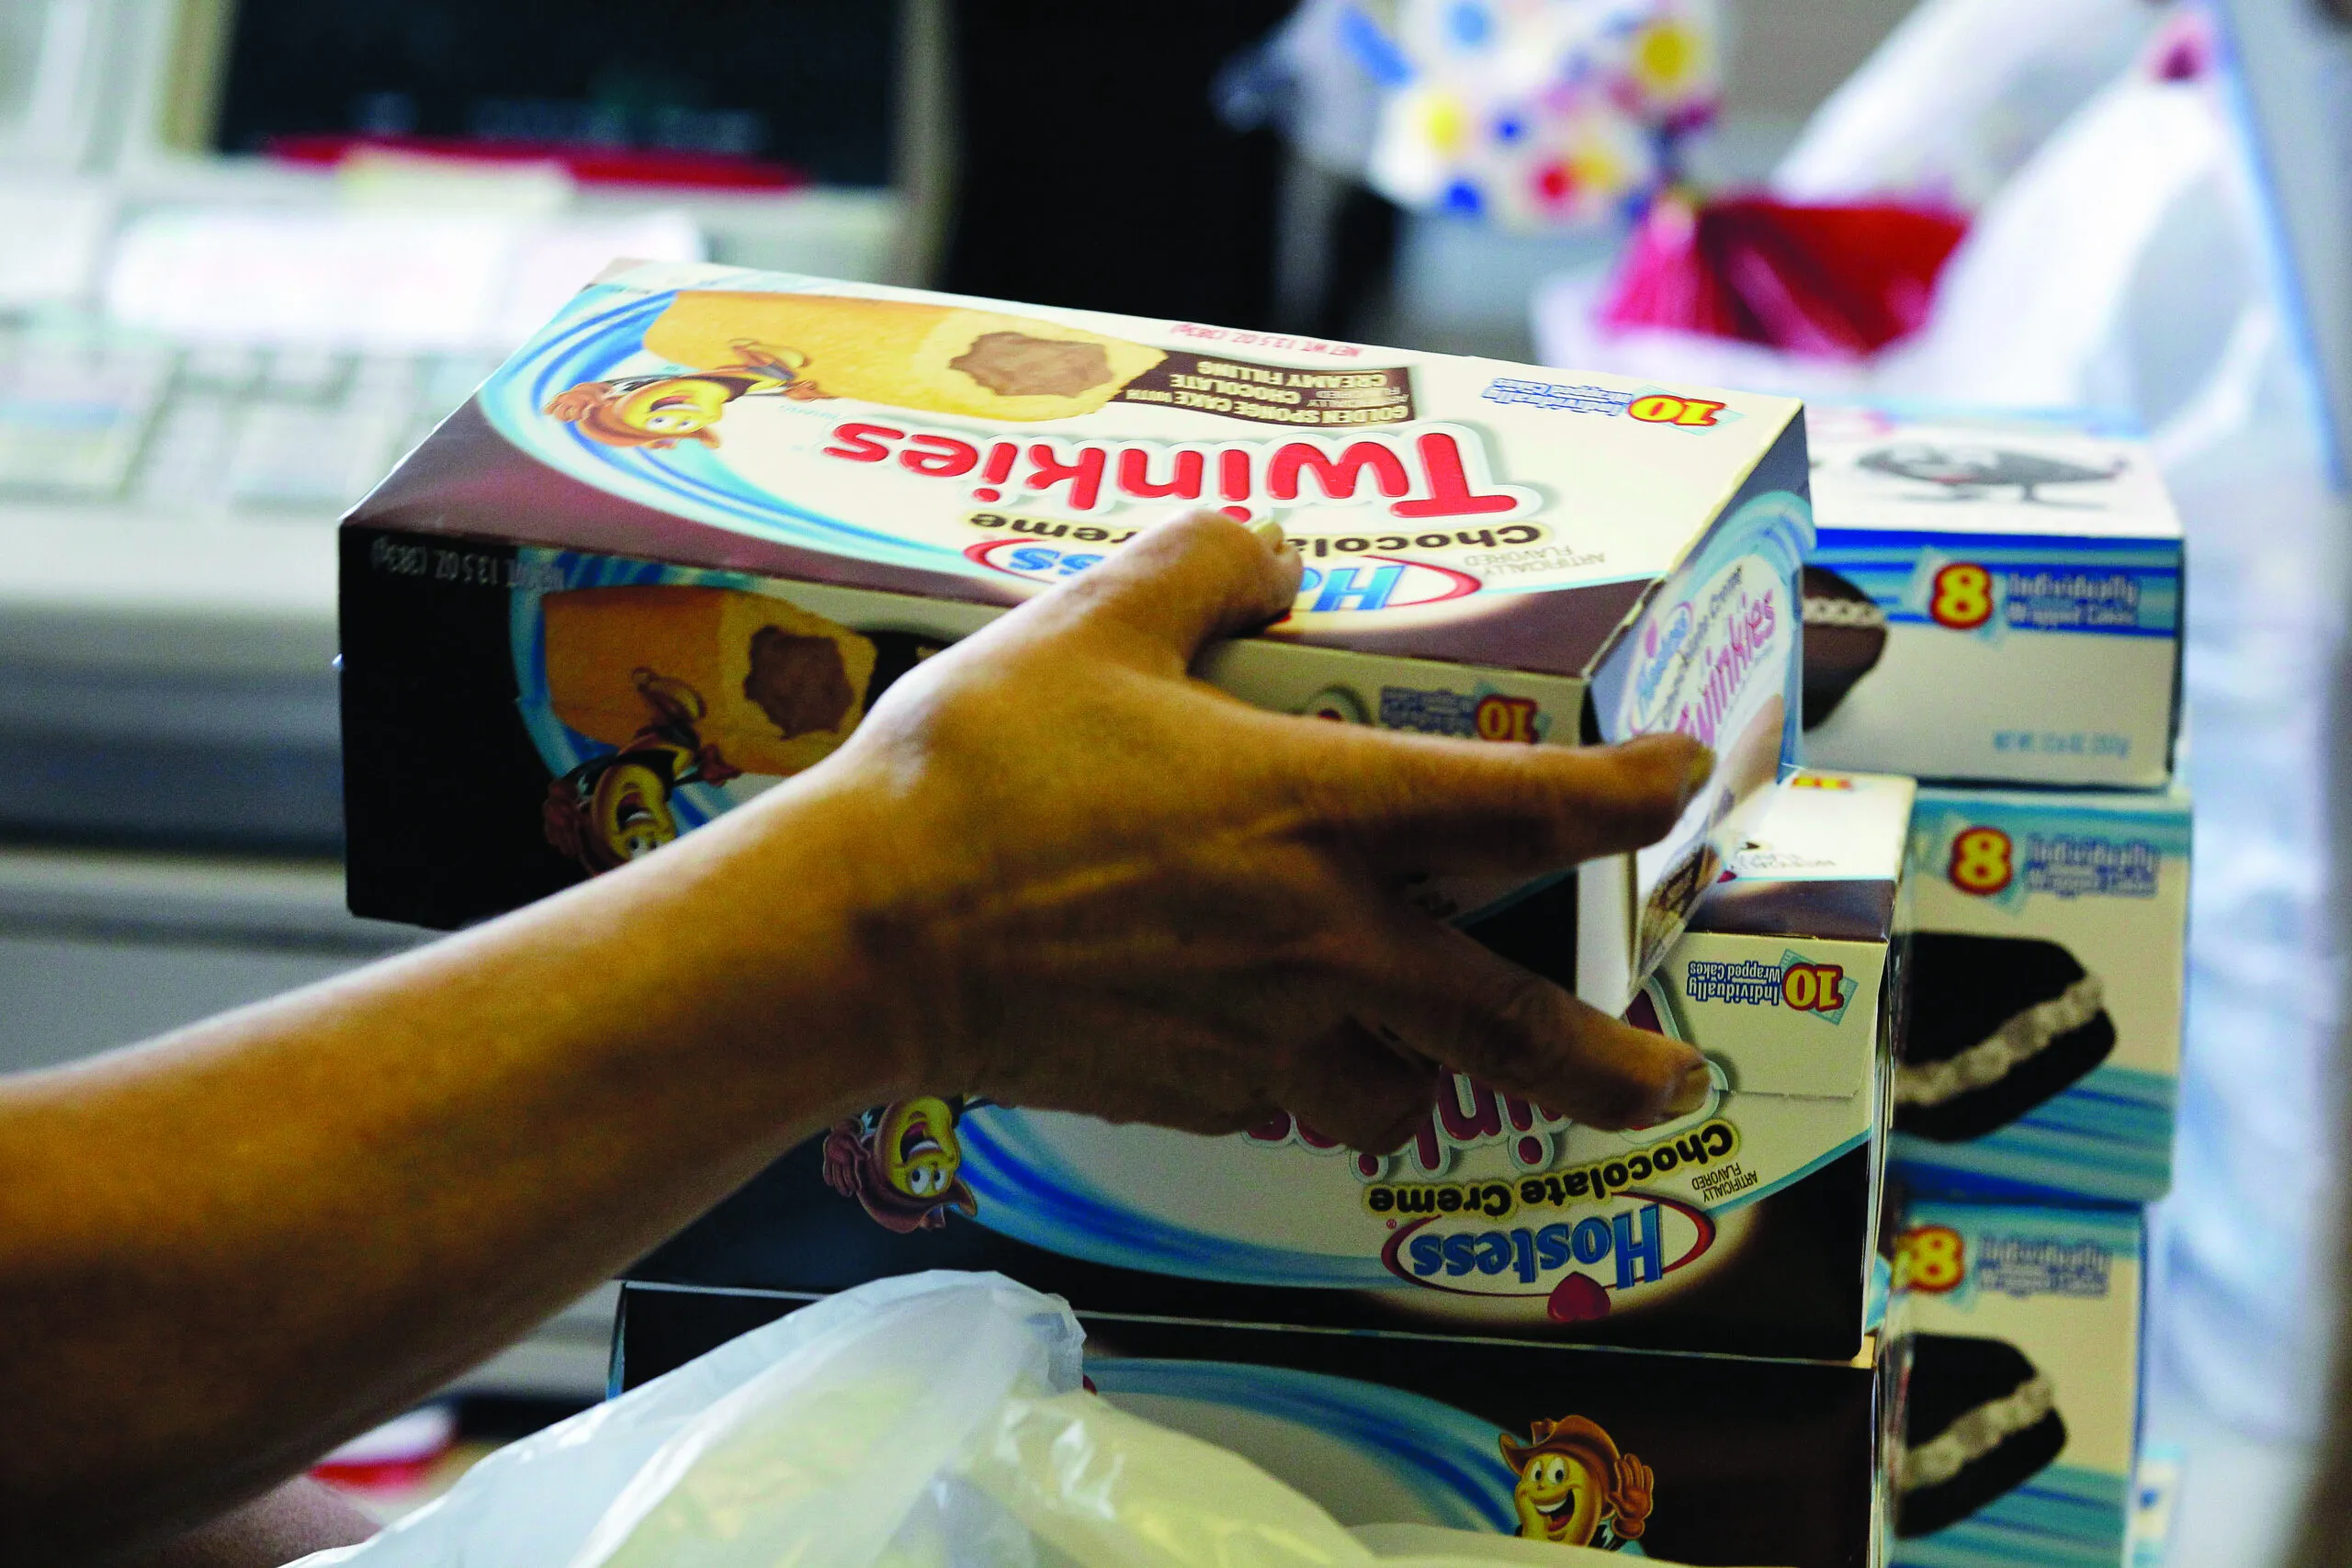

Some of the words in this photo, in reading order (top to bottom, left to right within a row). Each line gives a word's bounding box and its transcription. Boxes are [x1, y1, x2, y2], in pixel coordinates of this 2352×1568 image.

[1169, 374, 1301, 405] CHOCOLATE
[1197, 361, 1284, 386] FILLING
[1286, 374, 1387, 389] CREAMY
[1173, 390, 1233, 412] CAKE
[1233, 400, 1321, 423] SPONGE
[1321, 405, 1409, 423] GOLDEN
[1627, 393, 1726, 426] 10
[823, 422, 1518, 524] Twinkies
[970, 513, 1137, 545] reme
[1286, 525, 1542, 558] Chocola
[1464, 545, 1573, 566] FLAVORED
[1486, 552, 1605, 576] ARTIFICIALLY
[1930, 562, 1994, 630] 8
[1476, 694, 1540, 744] 10
[1948, 826, 2013, 896] 8
[1689, 960, 1725, 980] Cakes
[1726, 960, 1782, 983] Wrapped
[1688, 977, 1781, 1007] Individually
[1782, 963, 1845, 1011] 10
[1521, 1123, 1734, 1207] Chocolate
[1691, 1162, 1742, 1190] FLAVORED
[1368, 1184, 1512, 1217] Creme
[1702, 1170, 1758, 1202] ARTIFICIALLY
[1409, 1202, 1665, 1291] Hostess
[1904, 1224, 1965, 1296] 8
